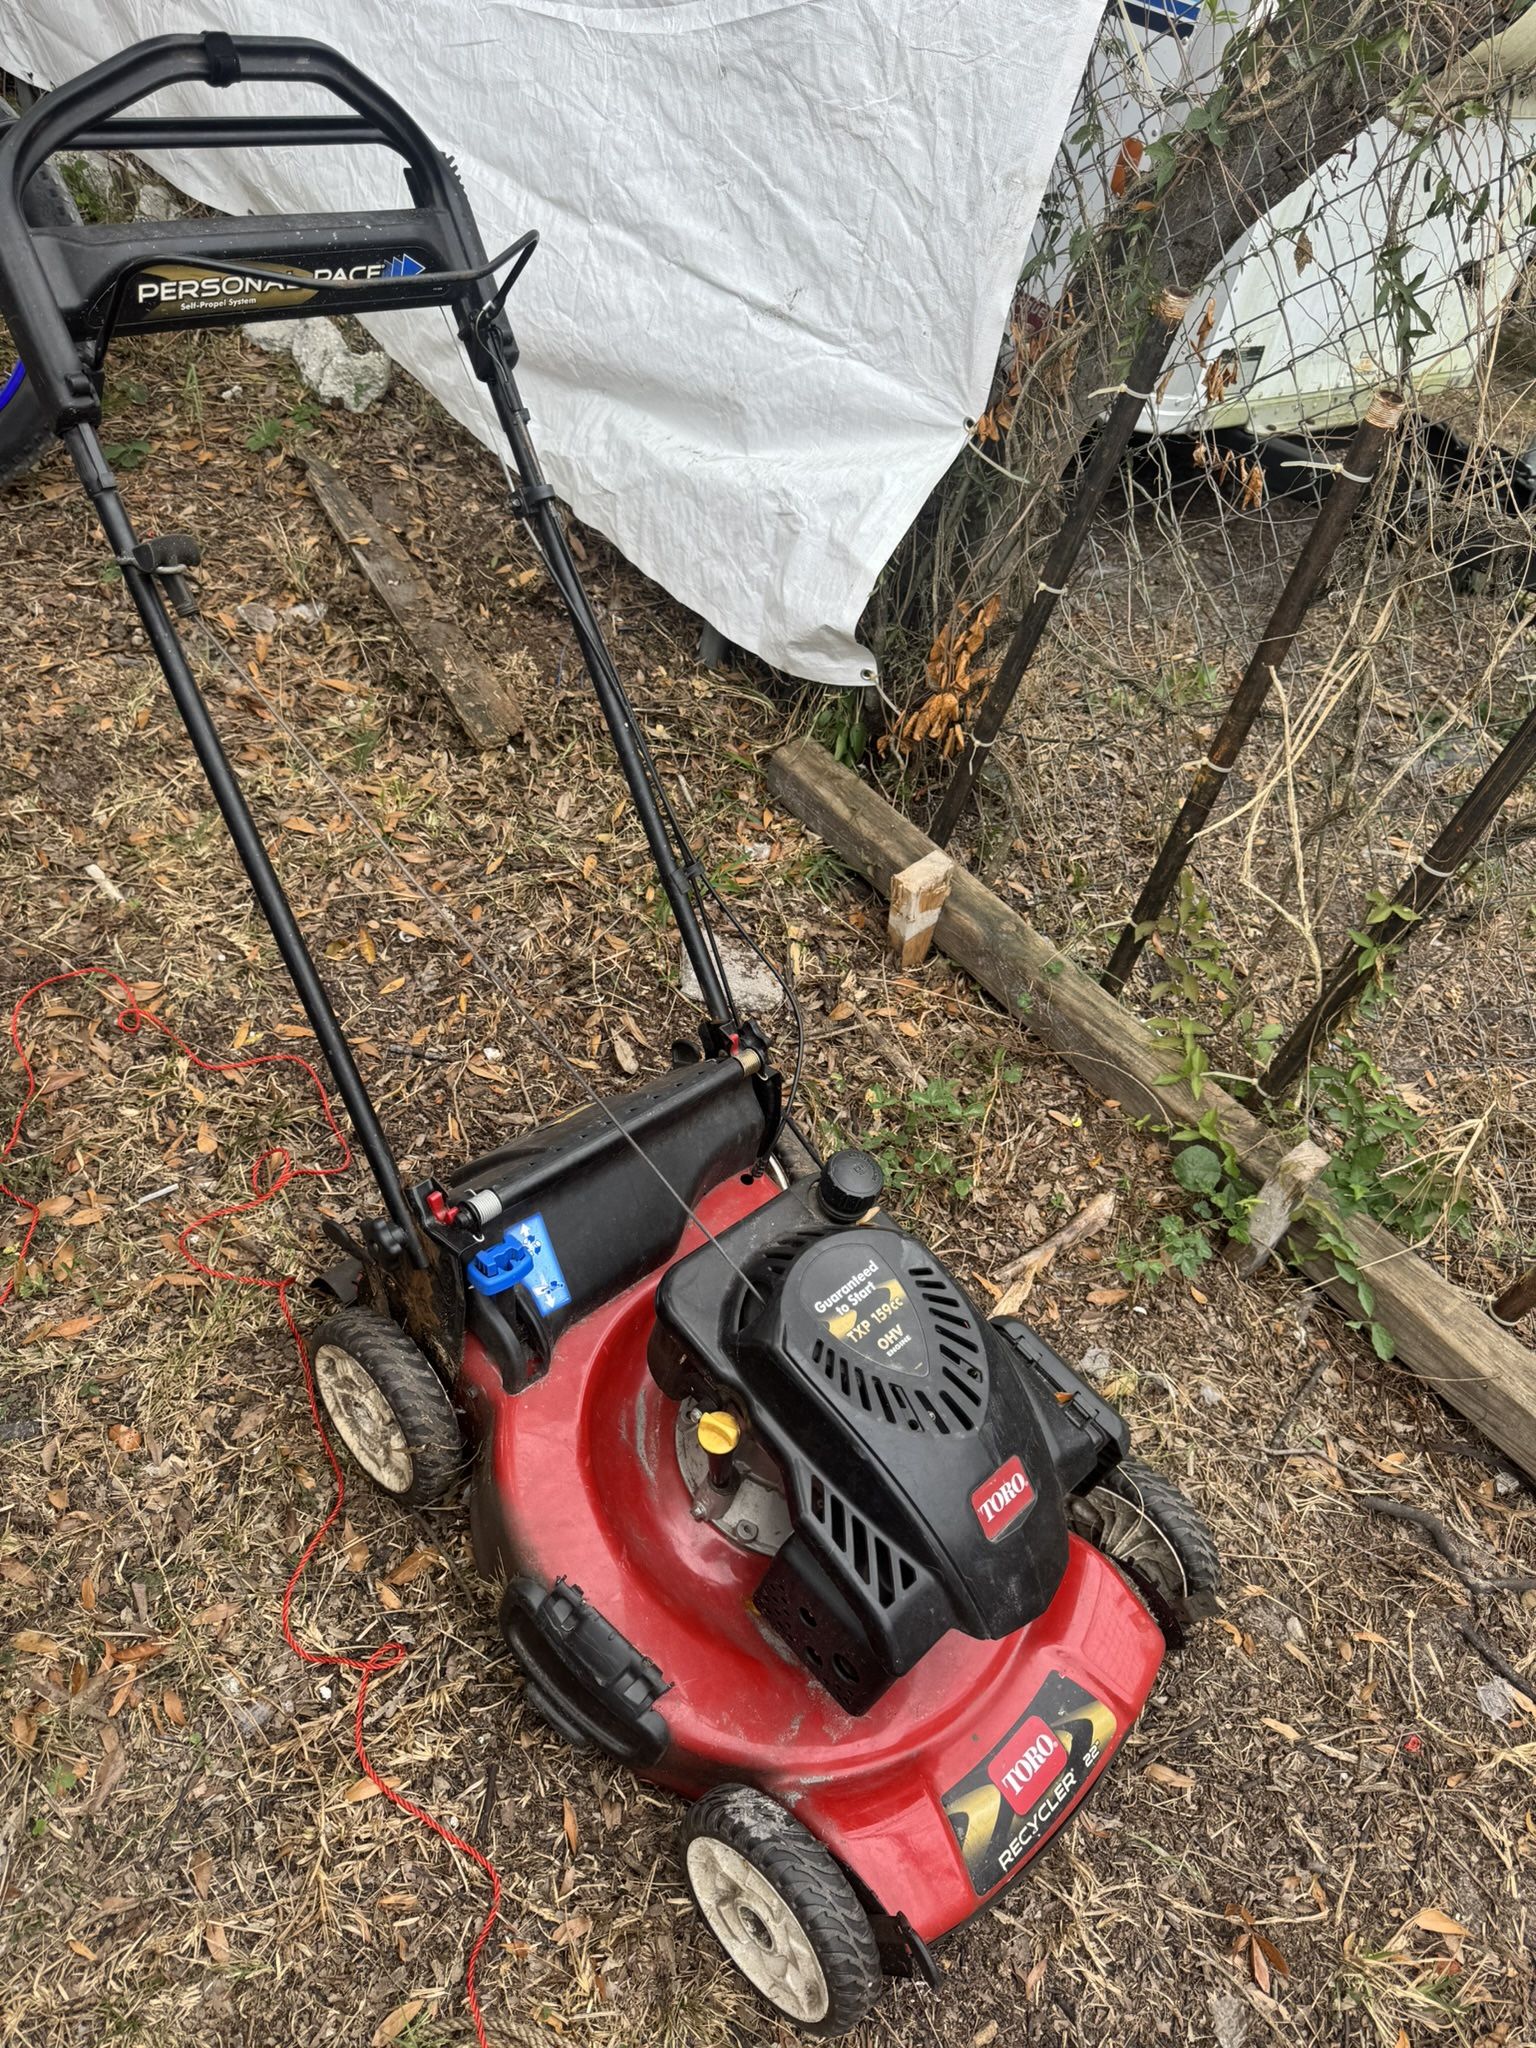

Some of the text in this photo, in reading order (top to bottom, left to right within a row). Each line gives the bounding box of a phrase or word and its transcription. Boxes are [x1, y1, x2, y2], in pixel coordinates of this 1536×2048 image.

[180, 297, 257, 311] Self-Propel System
[814, 1259, 879, 1313] Guaranteed
[835, 1281, 877, 1316] to Start
[846, 1297, 904, 1344] TXP 159cc
[877, 1323, 904, 1350] OHV
[886, 1334, 913, 1357] ENGINE
[977, 1472, 1027, 1523] TORO
[1001, 1733, 1056, 1796] TORO
[998, 1771, 1077, 1872] RECYCLER
